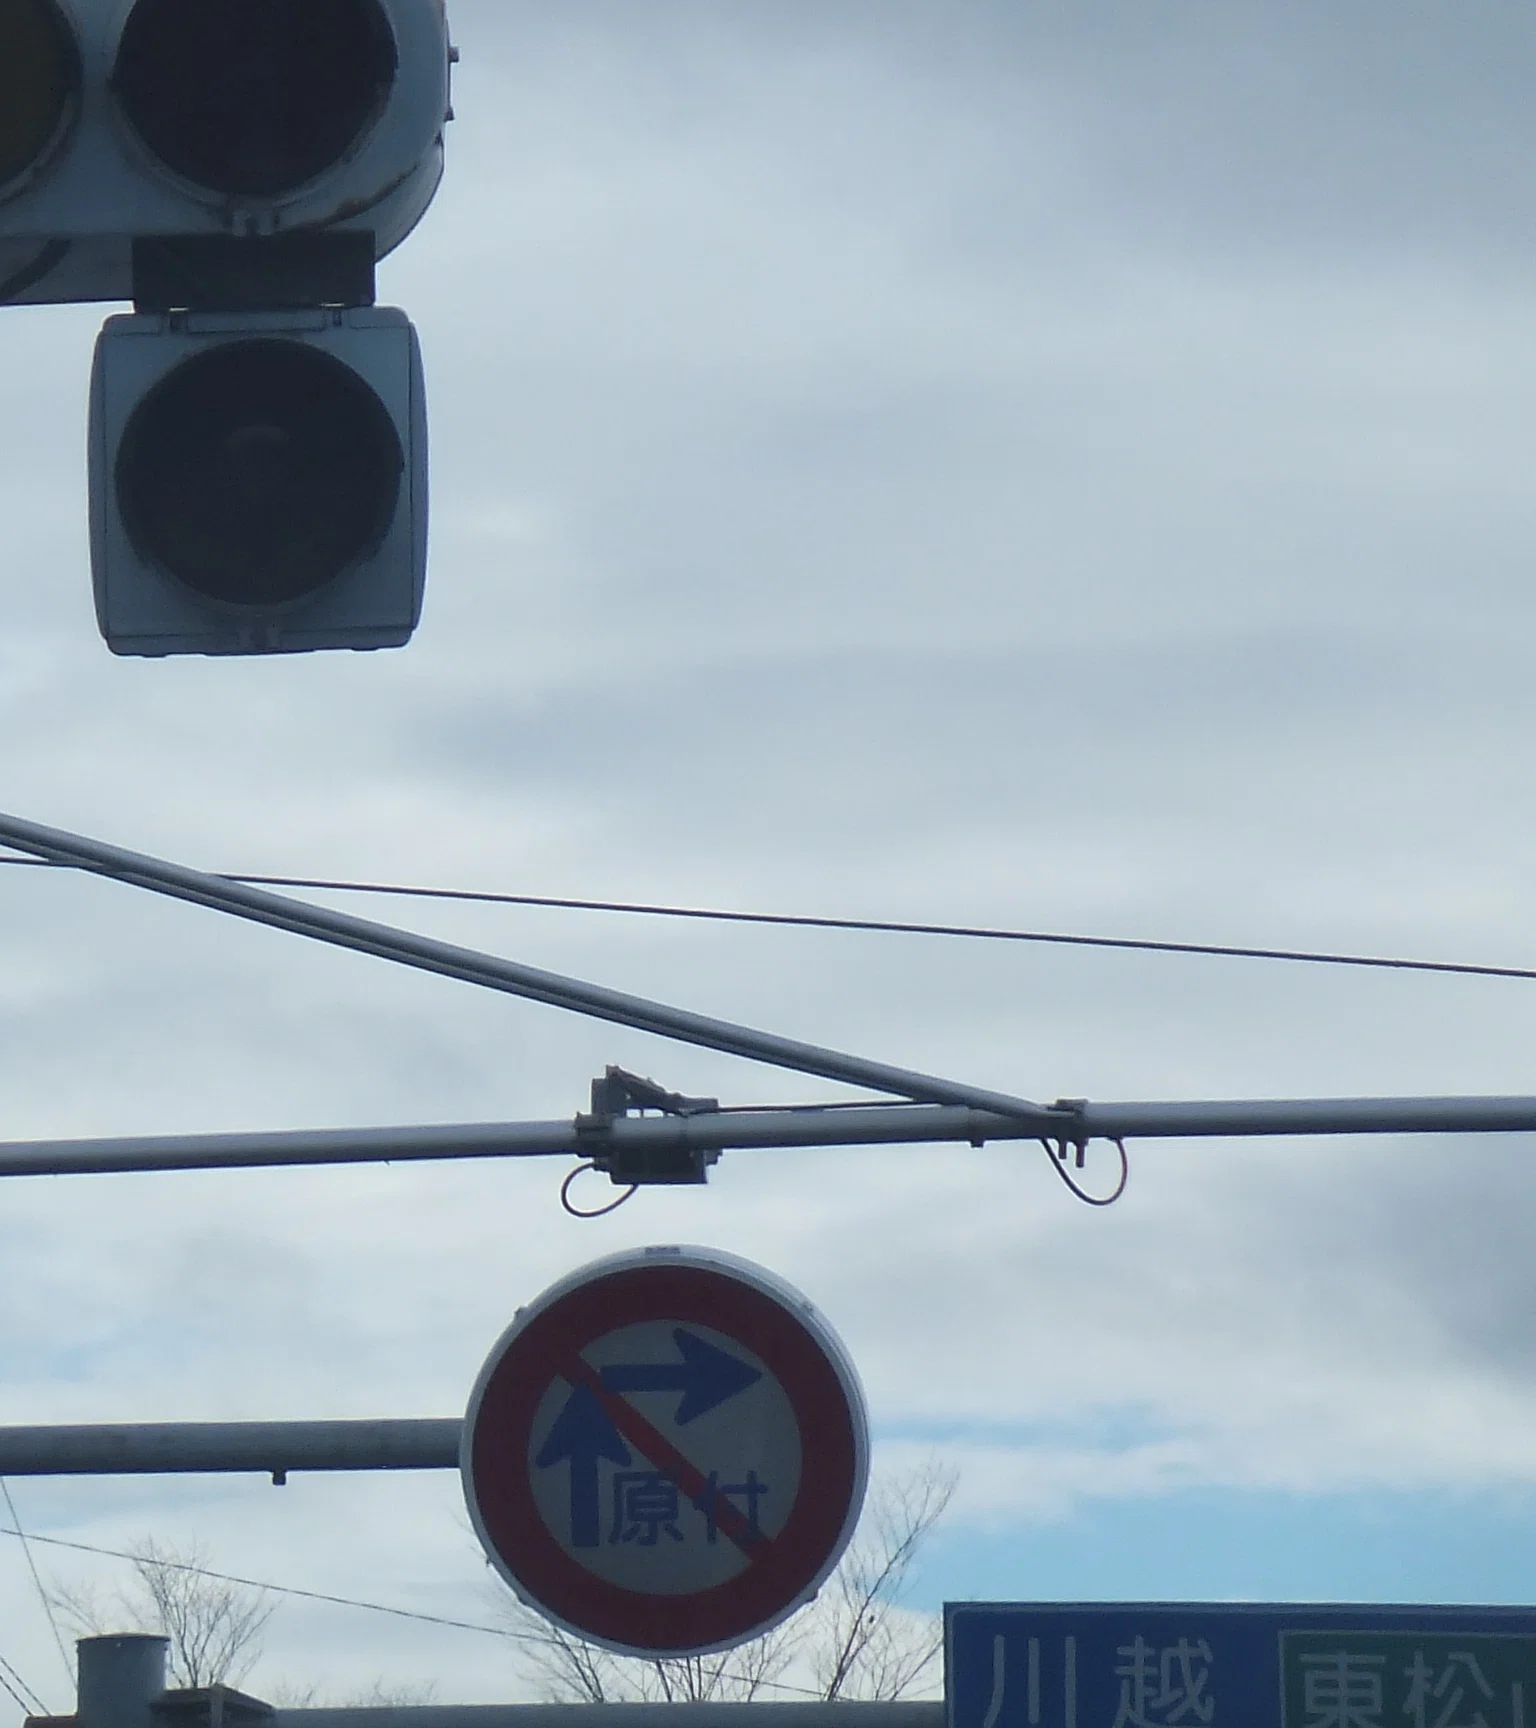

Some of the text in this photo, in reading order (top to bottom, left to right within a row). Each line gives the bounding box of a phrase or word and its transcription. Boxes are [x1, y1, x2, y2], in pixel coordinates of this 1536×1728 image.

[609, 1468, 769, 1546] 原付
[983, 1634, 1215, 1728] 川越
[1299, 1649, 1526, 1728] 東松
